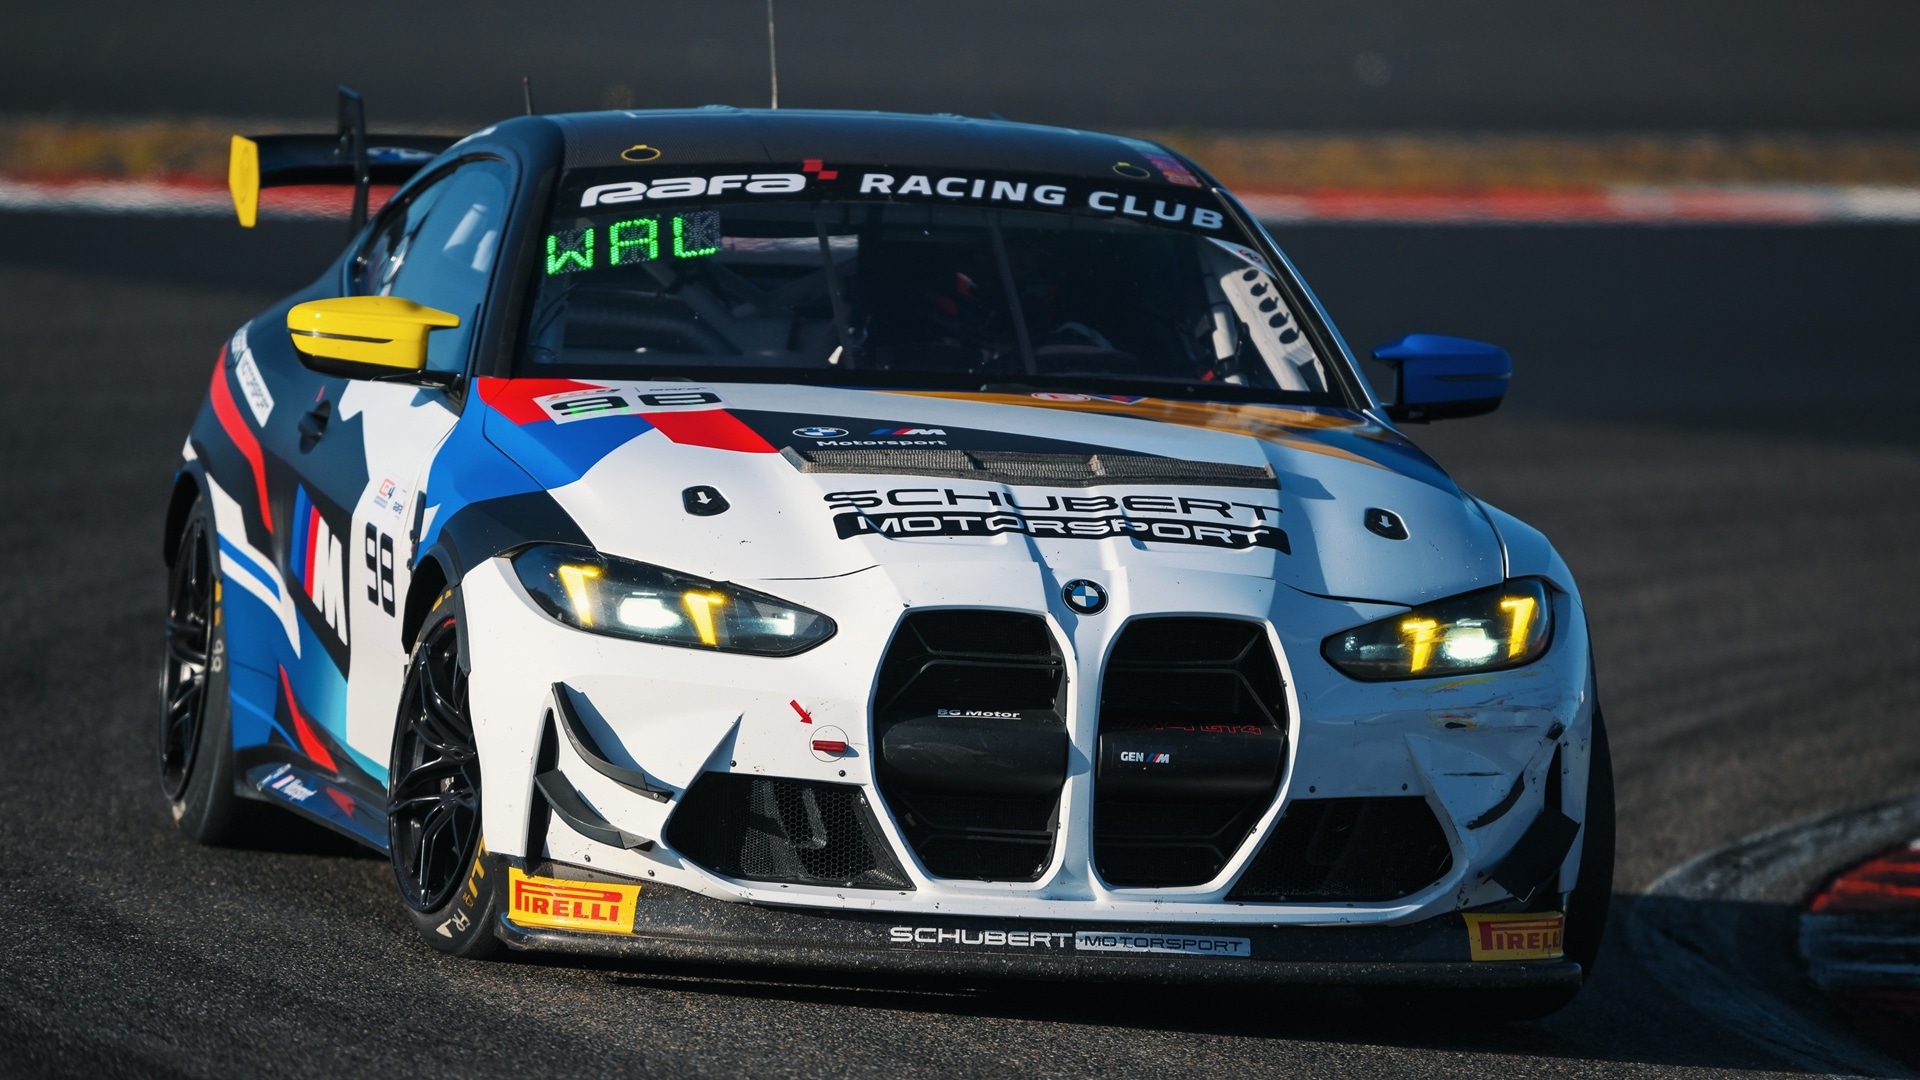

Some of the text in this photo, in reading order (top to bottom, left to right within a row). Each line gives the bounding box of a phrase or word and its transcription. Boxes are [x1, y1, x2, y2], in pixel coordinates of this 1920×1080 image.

[859, 173, 1067, 205] RACING
[1088, 191, 1224, 230] CLUB
[546, 216, 717, 274] WAL
[550, 392, 723, 417] 98
[823, 488, 1284, 522] SCHUBERT
[857, 515, 1270, 544] MOTORSPORT
[365, 521, 396, 618] 98
[937, 708, 1020, 719] BG Motor
[1120, 751, 1144, 762] GEN
[515, 879, 623, 922] PIRELLI
[890, 926, 1244, 953] SCHUBERT MOTORSPORT
